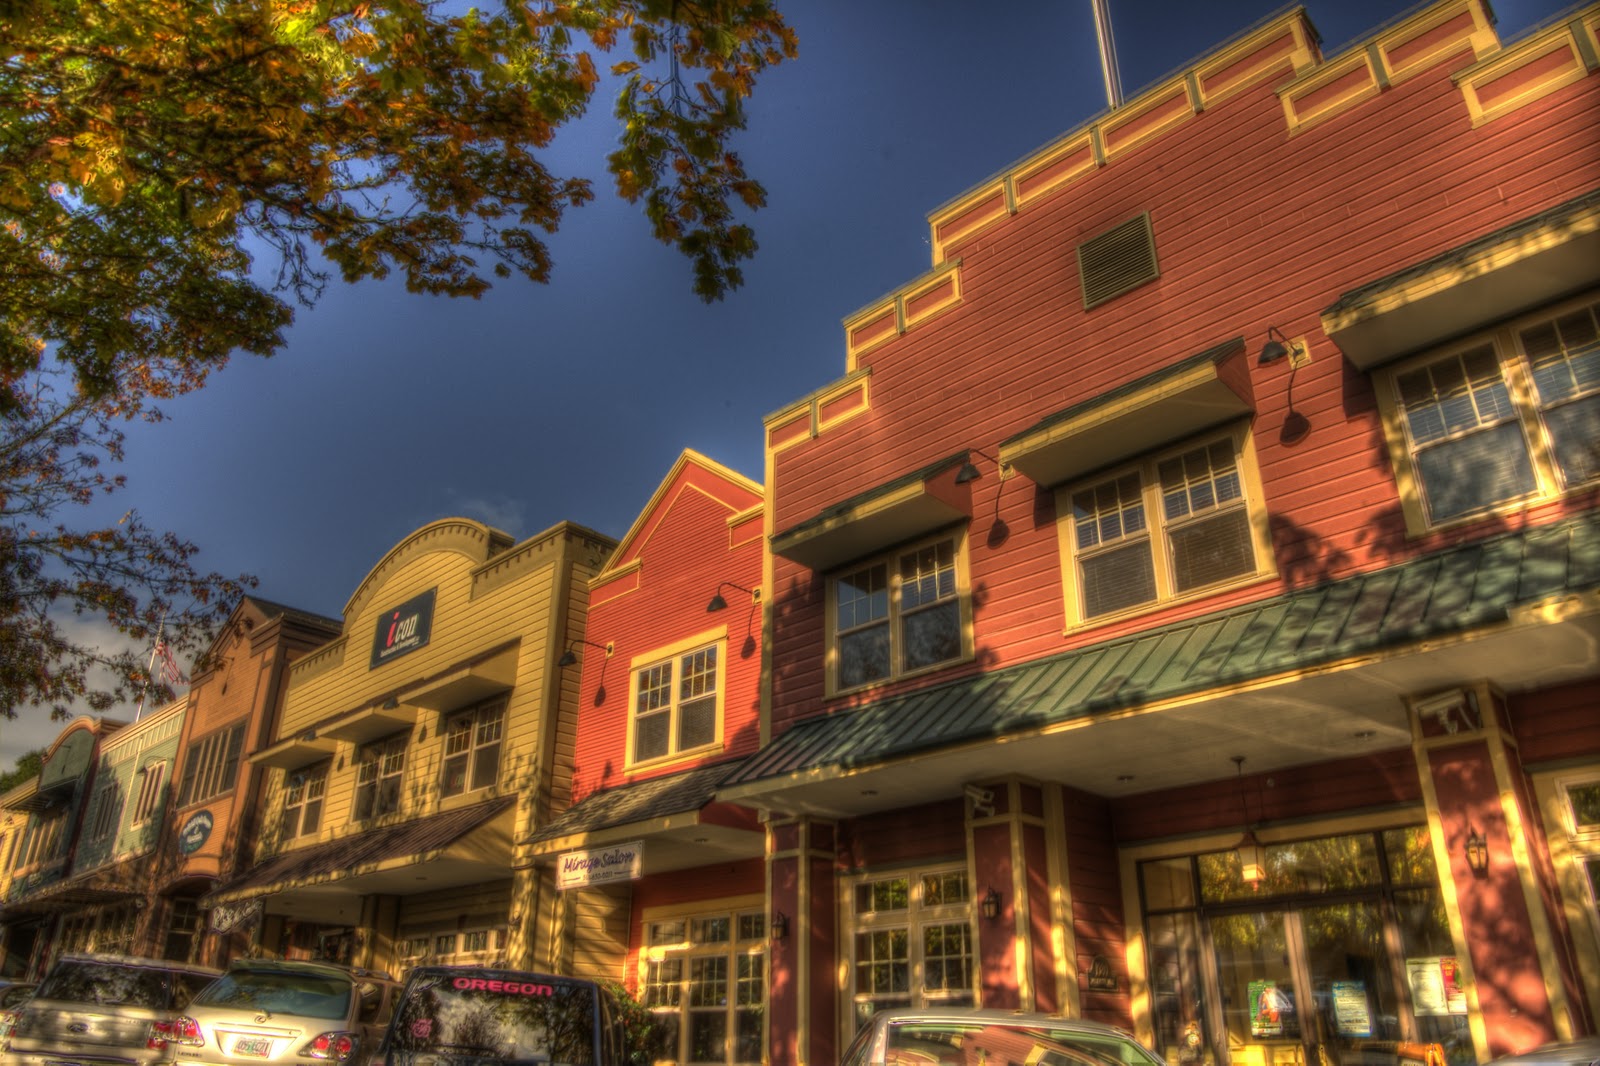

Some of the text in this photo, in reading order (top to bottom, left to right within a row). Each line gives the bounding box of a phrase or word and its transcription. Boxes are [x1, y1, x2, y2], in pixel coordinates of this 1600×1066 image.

[386, 611, 418, 648] icon
[563, 848, 635, 873] Mirage Salon
[452, 977, 553, 997] OREGON
